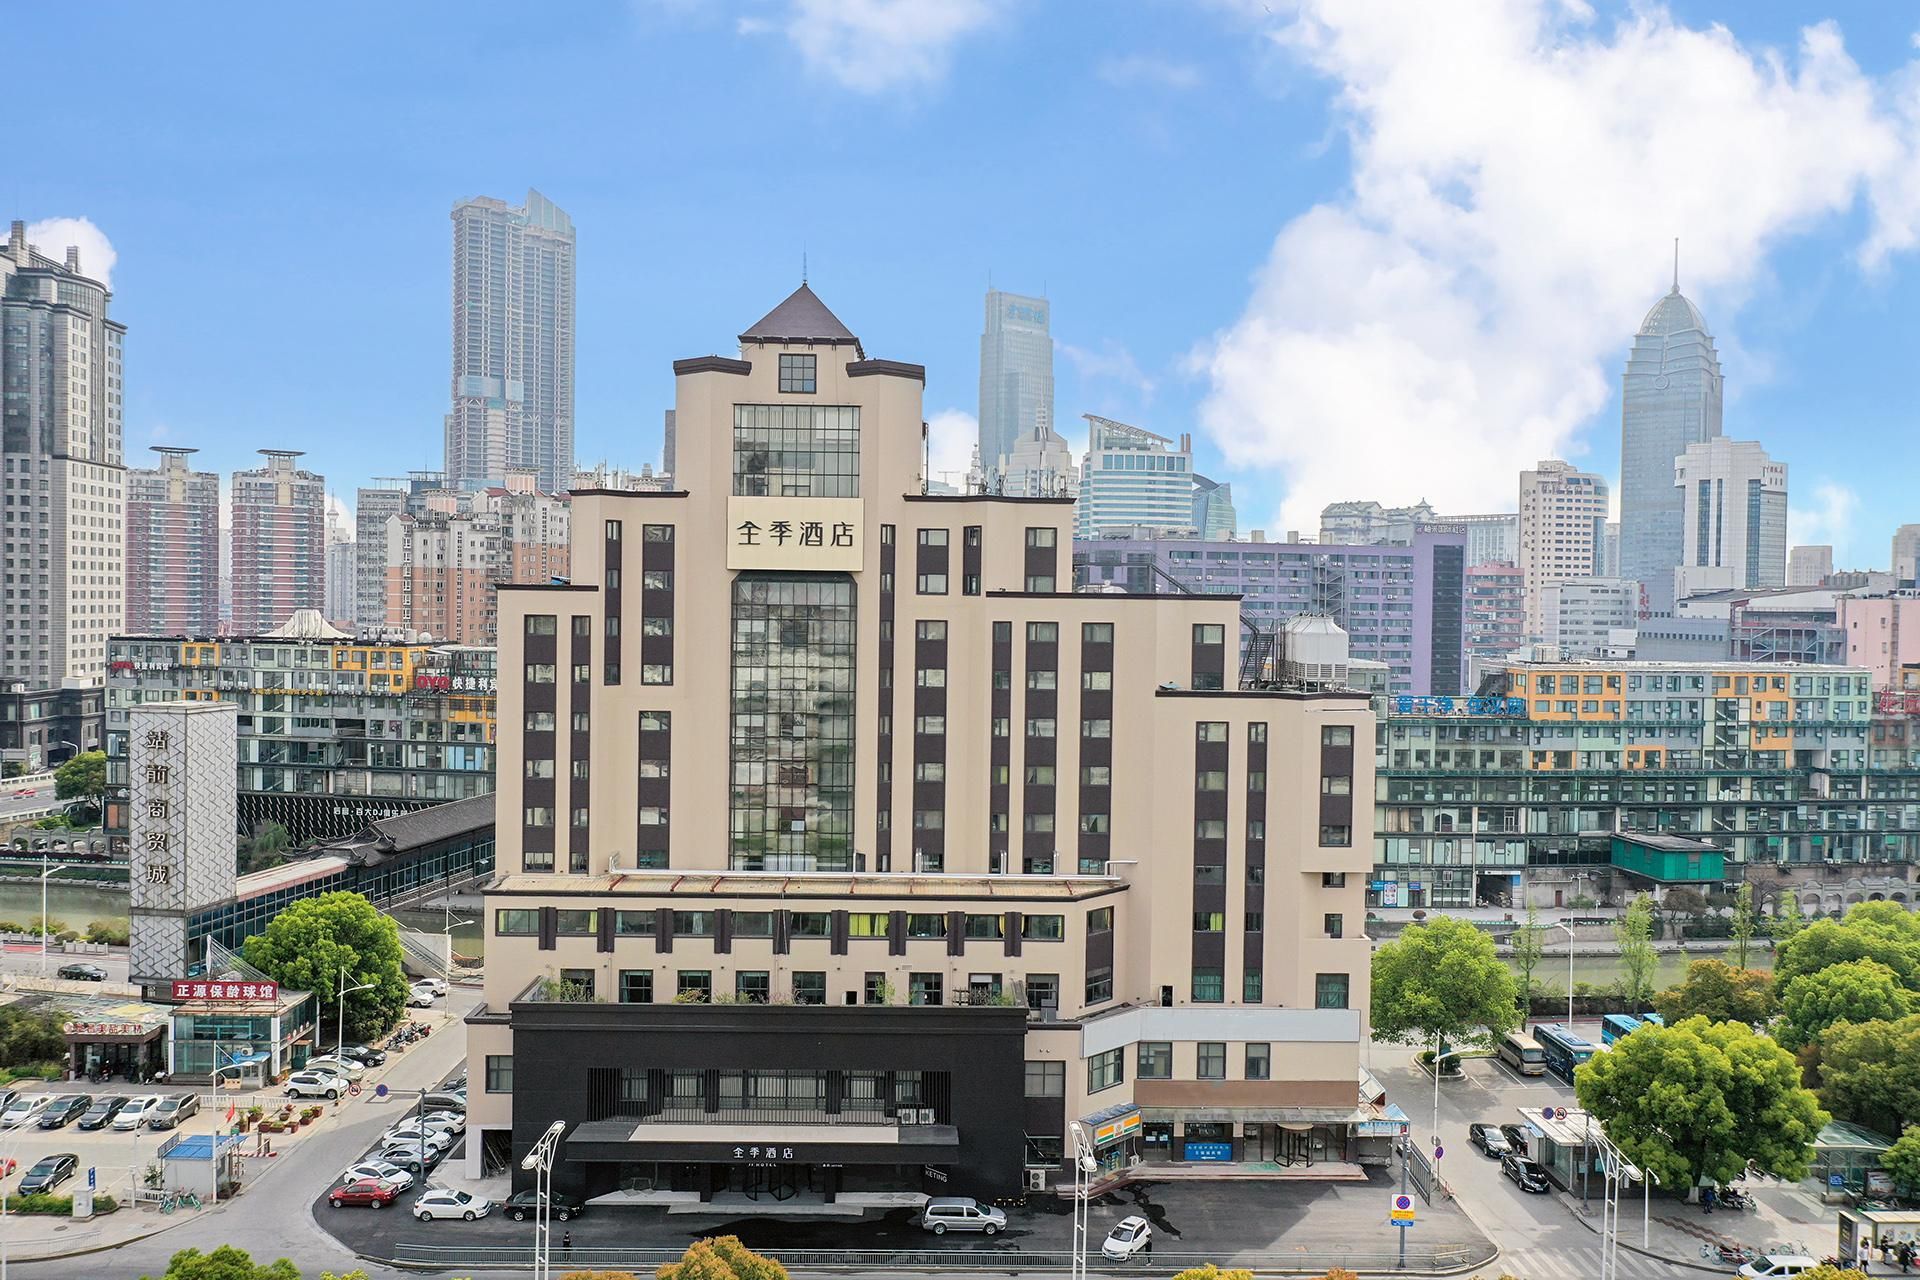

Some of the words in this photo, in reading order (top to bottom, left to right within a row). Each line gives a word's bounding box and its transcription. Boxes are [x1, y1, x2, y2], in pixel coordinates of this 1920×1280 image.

[737, 520, 855, 547] 全季酒店
[416, 675, 449, 689] OYO
[146, 731, 169, 884] 站前商贸城
[176, 984, 274, 999] 正源保龄球馆
[733, 1147, 793, 1159] 全季酒店
